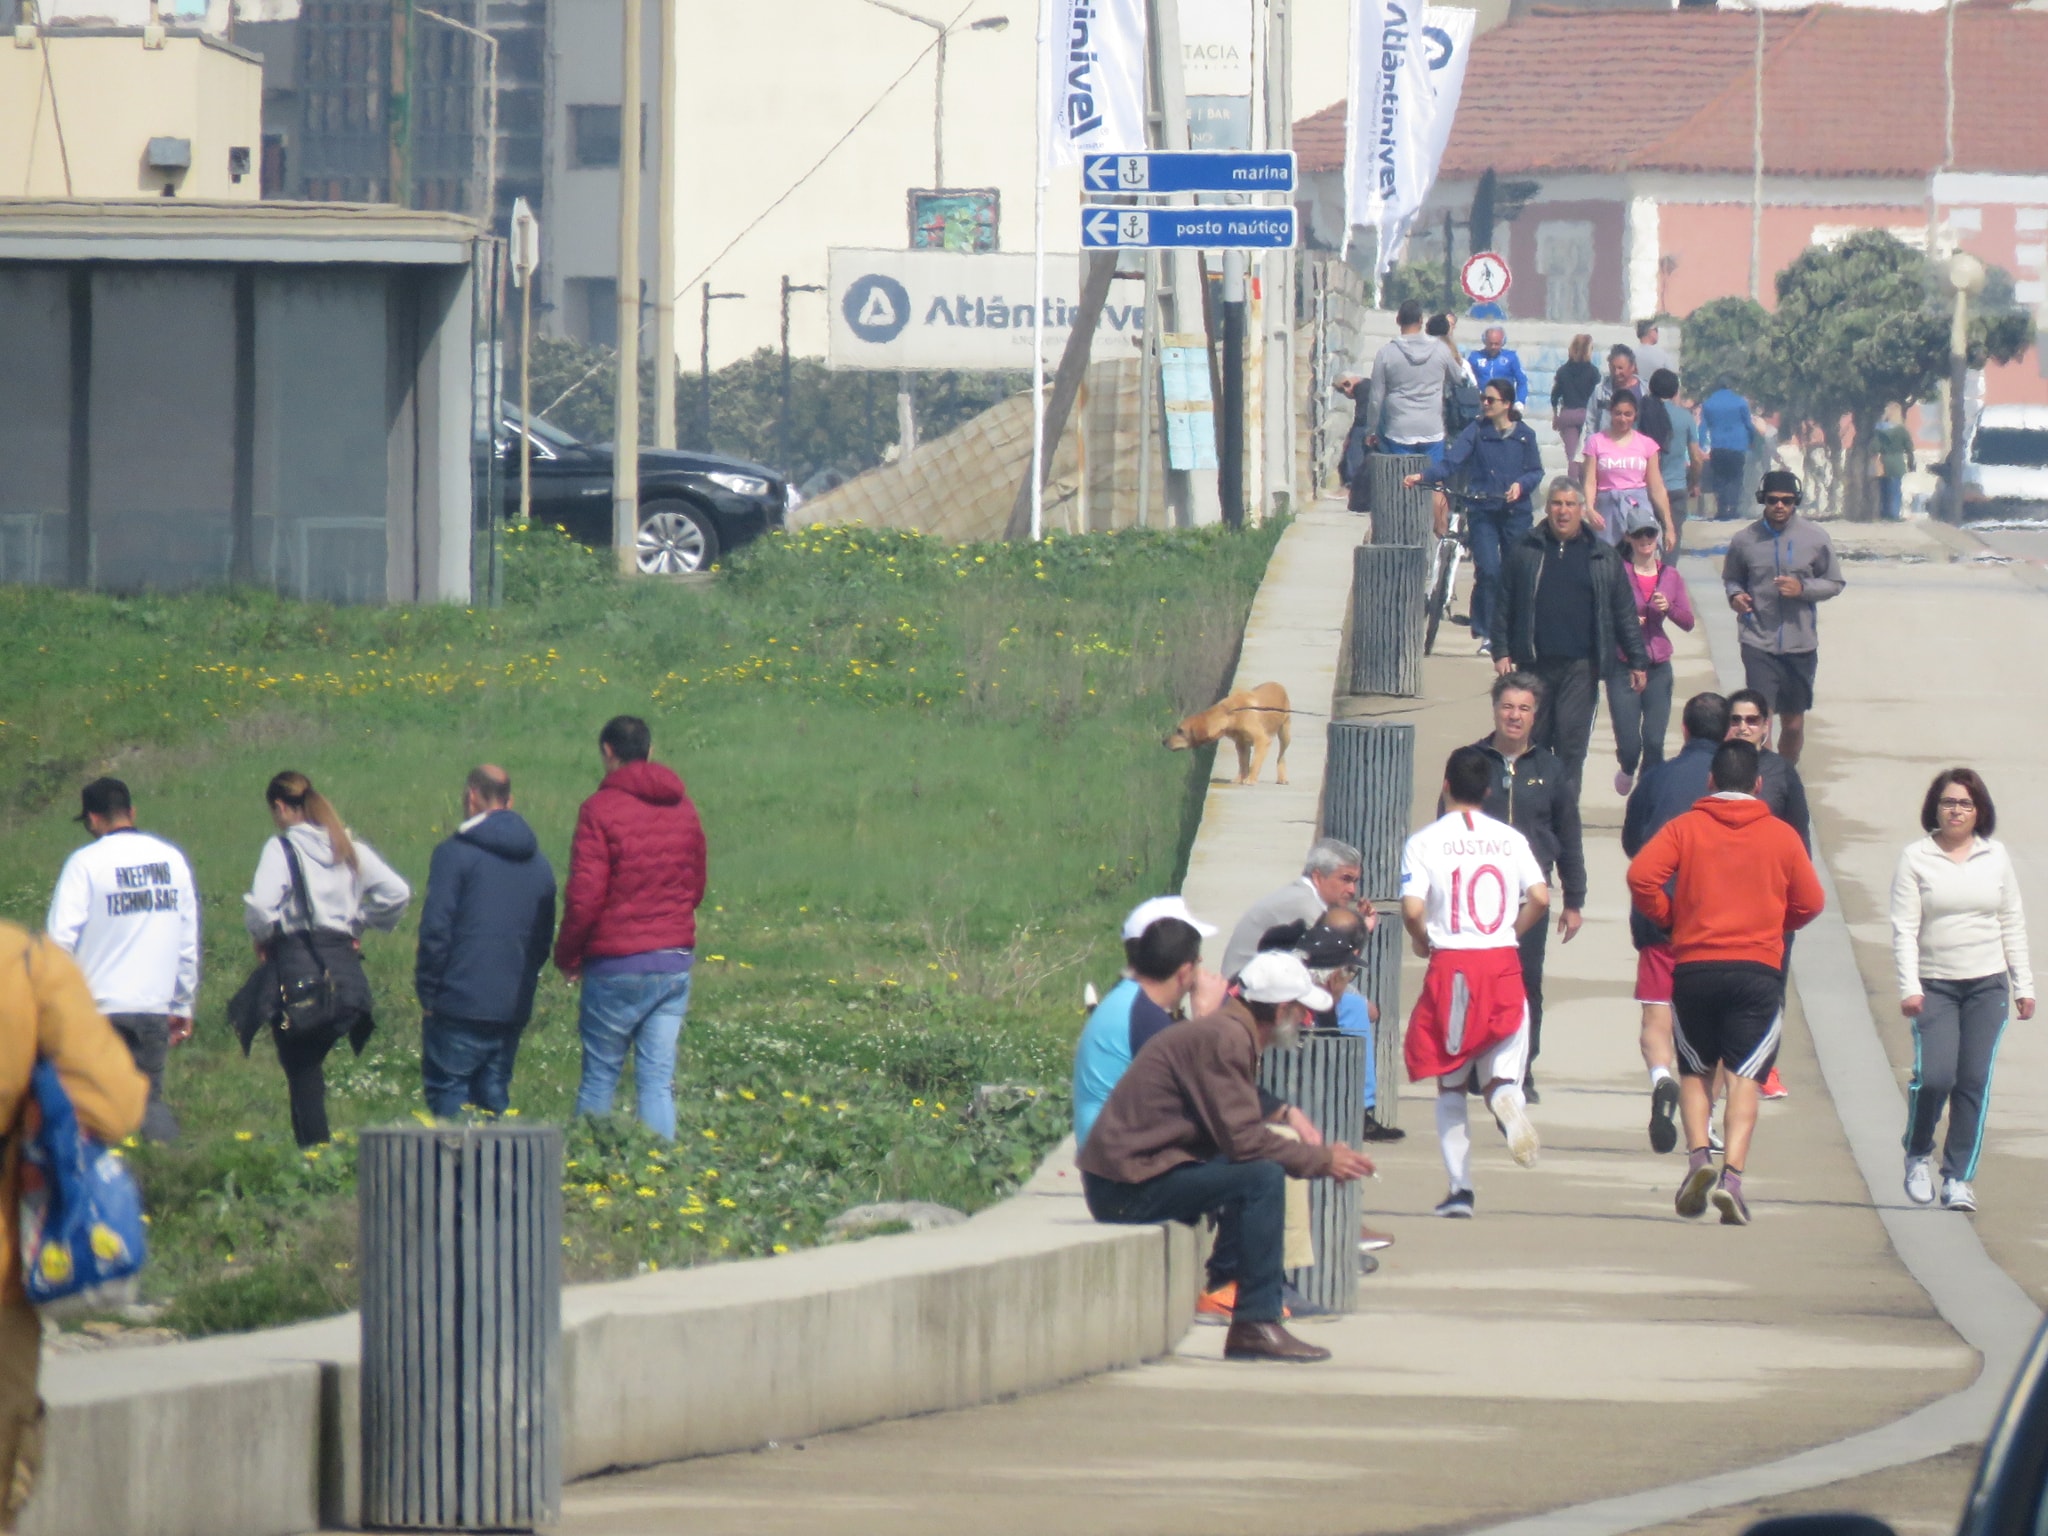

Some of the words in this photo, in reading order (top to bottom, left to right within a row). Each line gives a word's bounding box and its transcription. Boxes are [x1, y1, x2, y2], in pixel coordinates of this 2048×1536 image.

[1183, 44, 1239, 60] TACIA
[1232, 165, 1289, 180] marina
[1176, 221, 1223, 237] posto
[1443, 839, 1512, 856] GUSTAVO
[106, 889, 153, 916] TECHNO
[1451, 864, 1506, 935] 10
